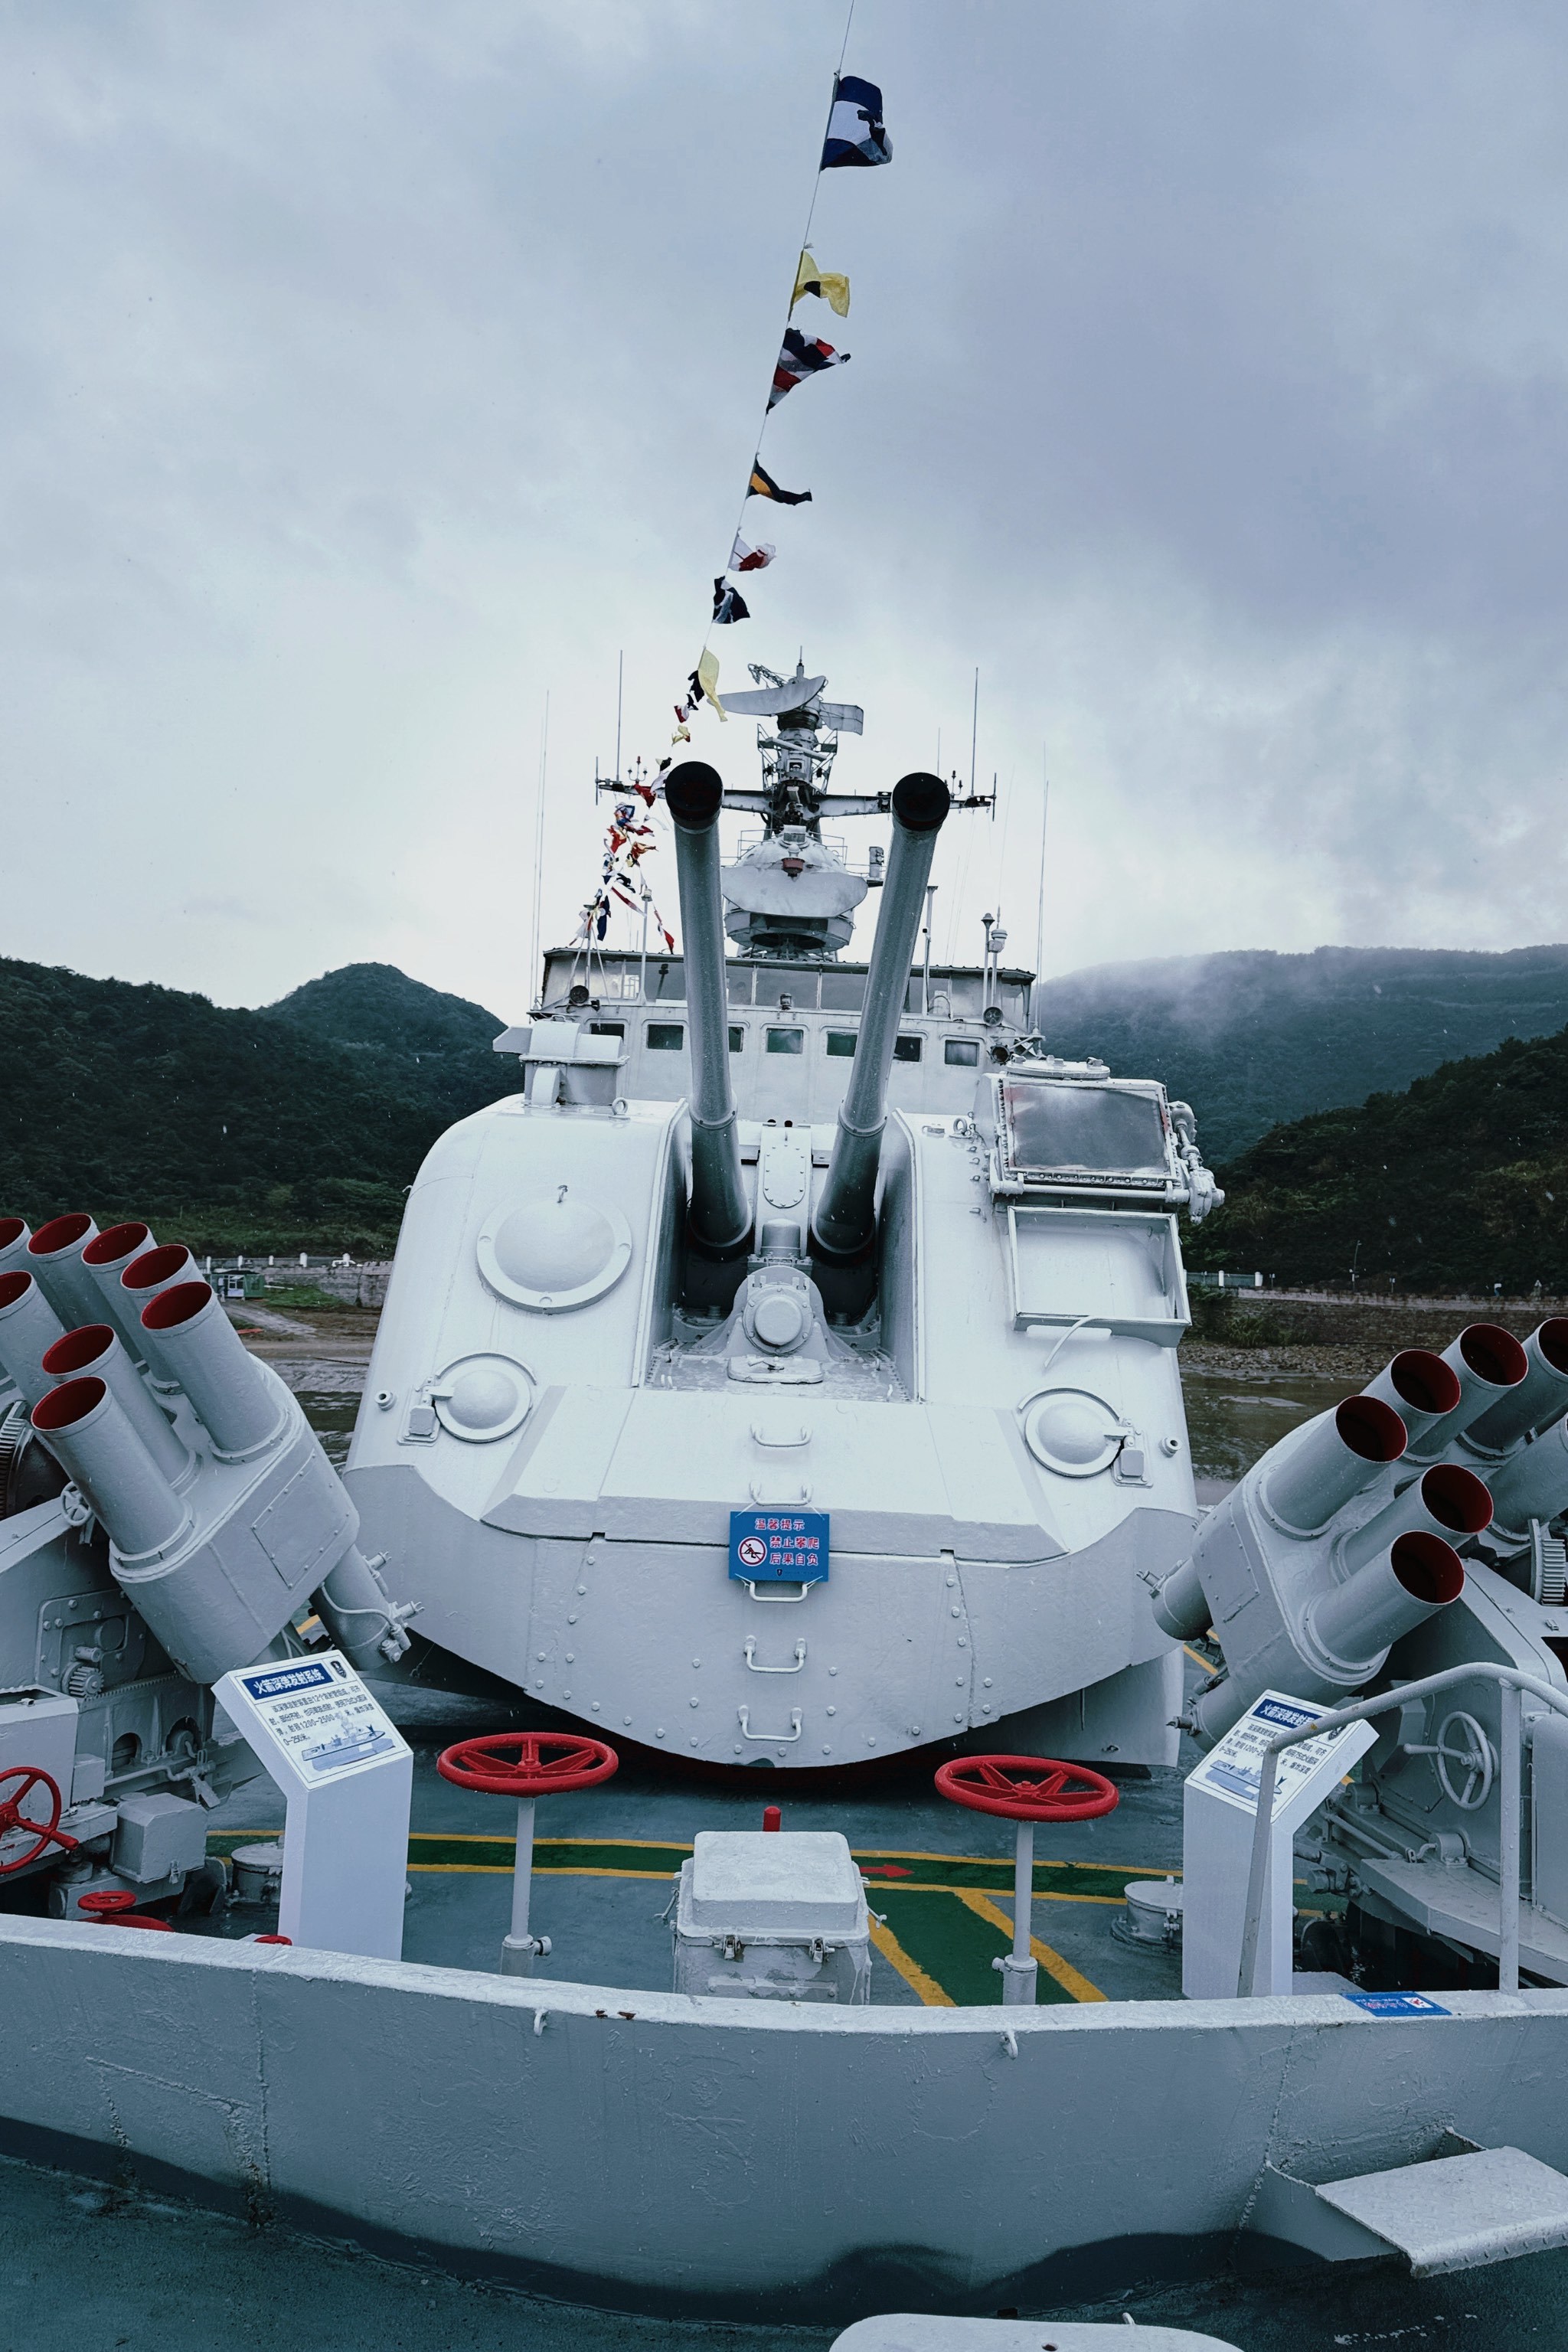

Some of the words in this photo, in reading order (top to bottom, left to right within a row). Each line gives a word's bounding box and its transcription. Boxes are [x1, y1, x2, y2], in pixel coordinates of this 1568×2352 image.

[755, 1518, 805, 1530] 温馨提示
[769, 1536, 820, 1549] 禁止攀爬
[769, 1553, 818, 1566] 后果自负
[253, 1668, 325, 1694] 火箭深弹发射系统
[1259, 1704, 1315, 1726] 火箭深弹发射
